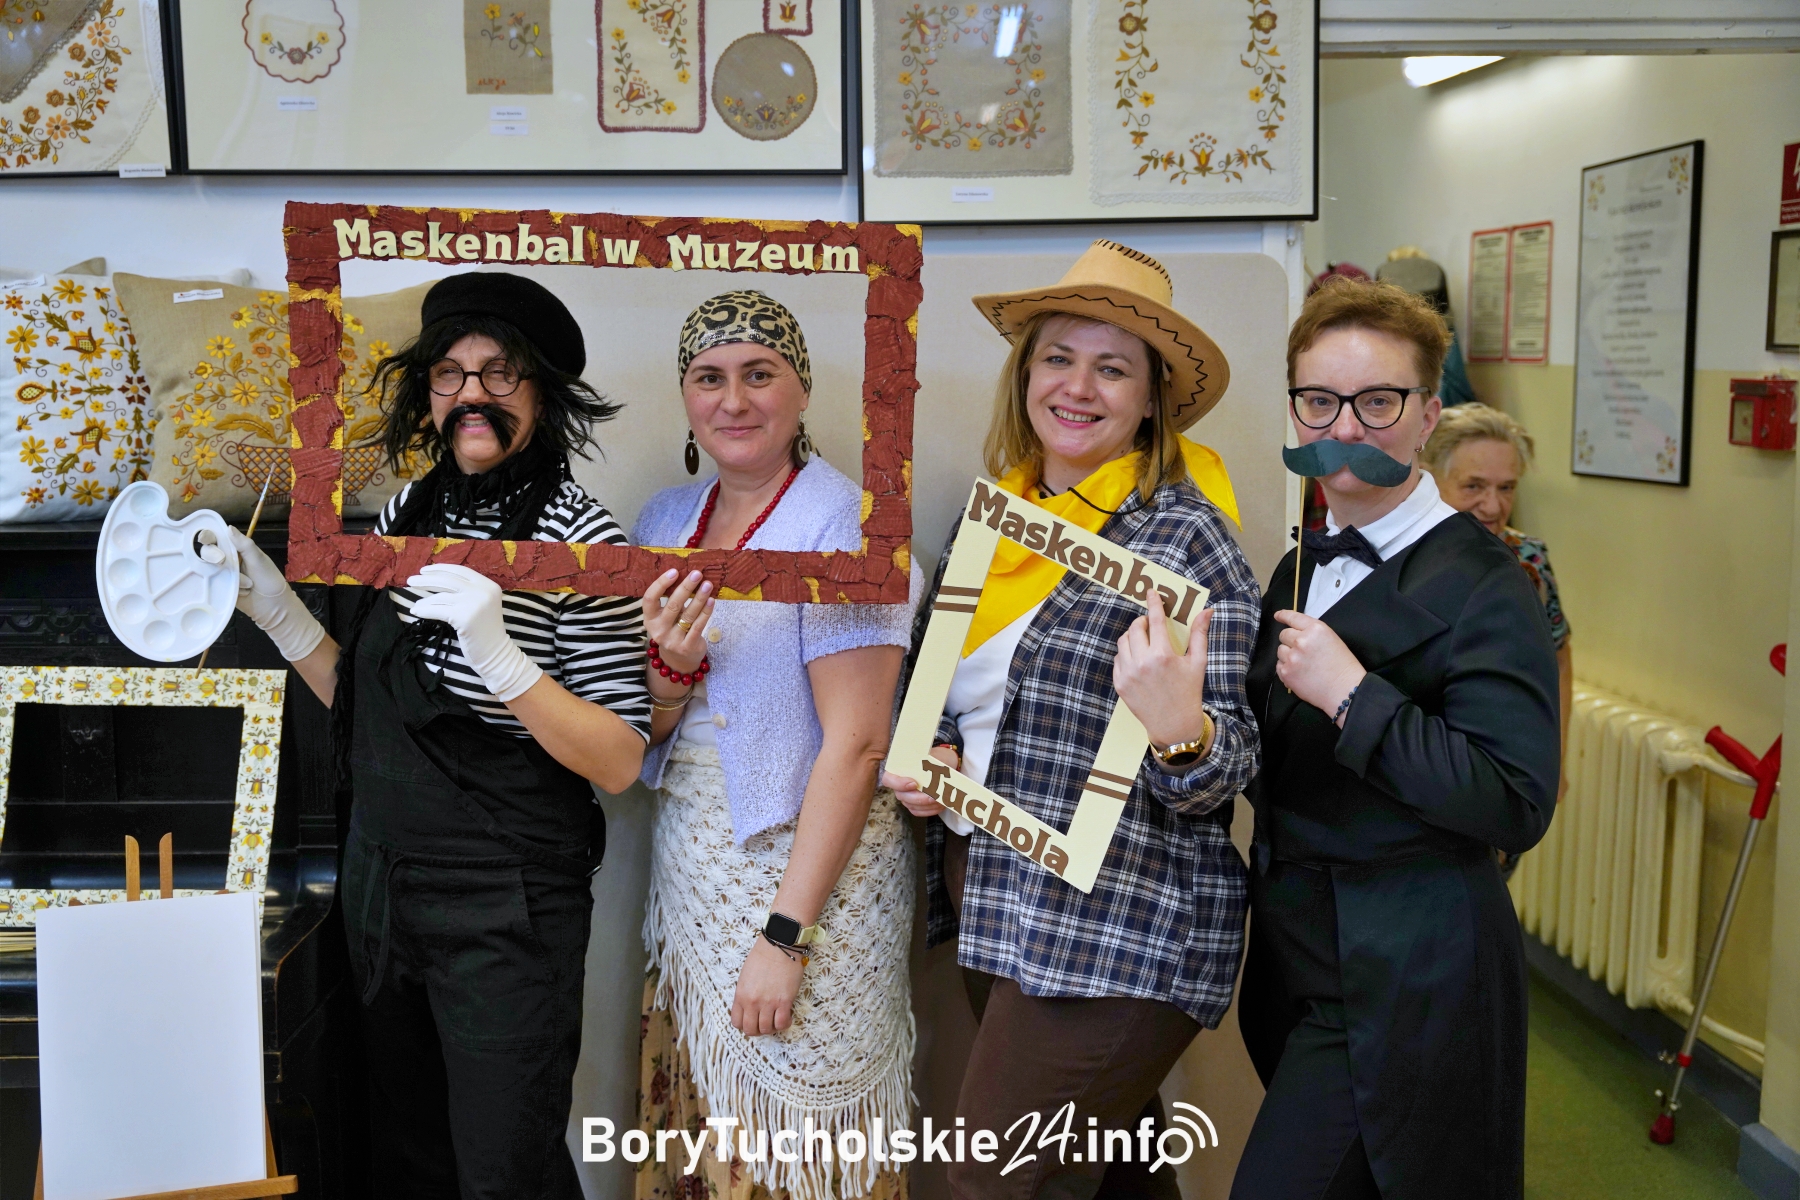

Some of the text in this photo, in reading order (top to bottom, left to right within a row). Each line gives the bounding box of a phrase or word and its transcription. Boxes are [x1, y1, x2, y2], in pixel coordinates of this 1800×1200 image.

[333, 218, 861, 272] Maskenbal w Muzeum
[968, 481, 1201, 626] Maskenbal
[922, 759, 1069, 877] Tuchola
